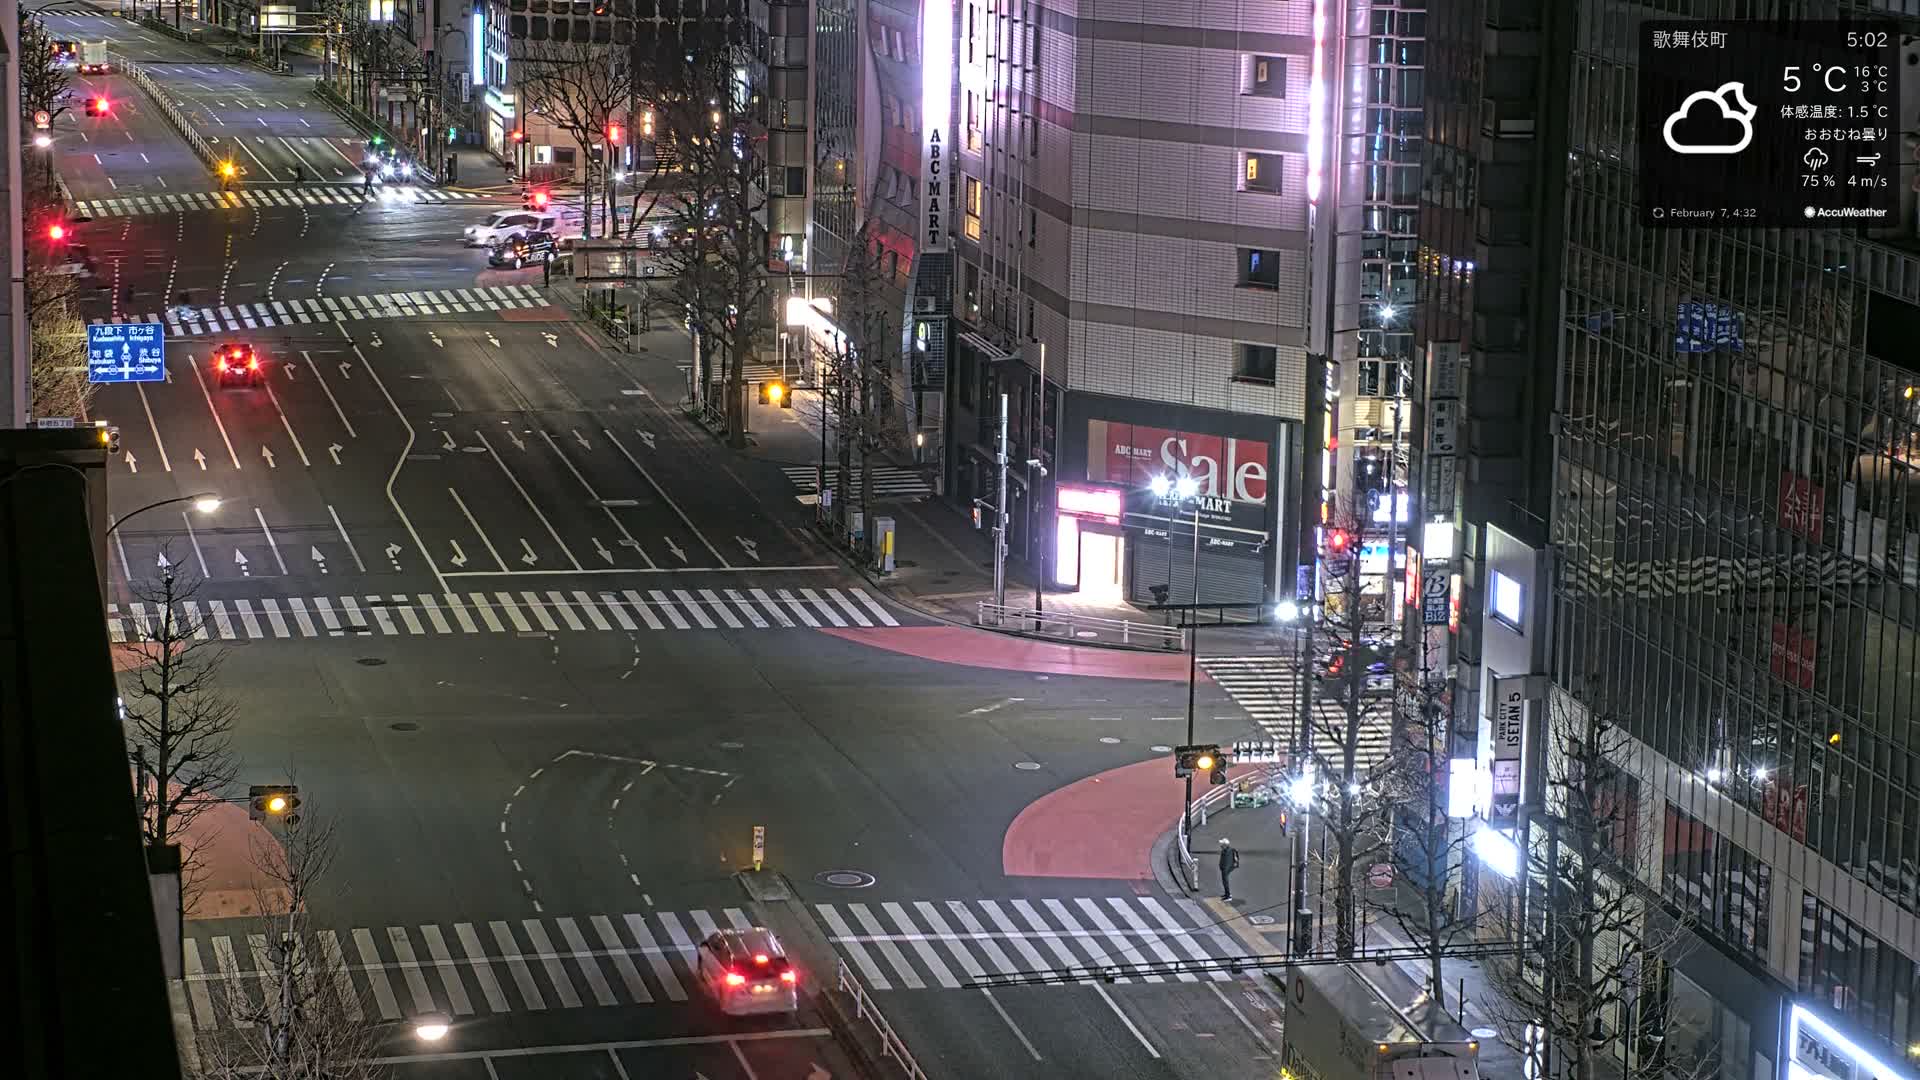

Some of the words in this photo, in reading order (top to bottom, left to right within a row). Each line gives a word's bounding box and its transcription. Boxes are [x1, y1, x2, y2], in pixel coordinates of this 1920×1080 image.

[95, 326, 122, 336] 九段下
[1160, 437, 1267, 505] Sale
[1509, 692, 1521, 702] 5
[1499, 702, 1507, 720] CITY
[1507, 706, 1520, 747] ISETAN
